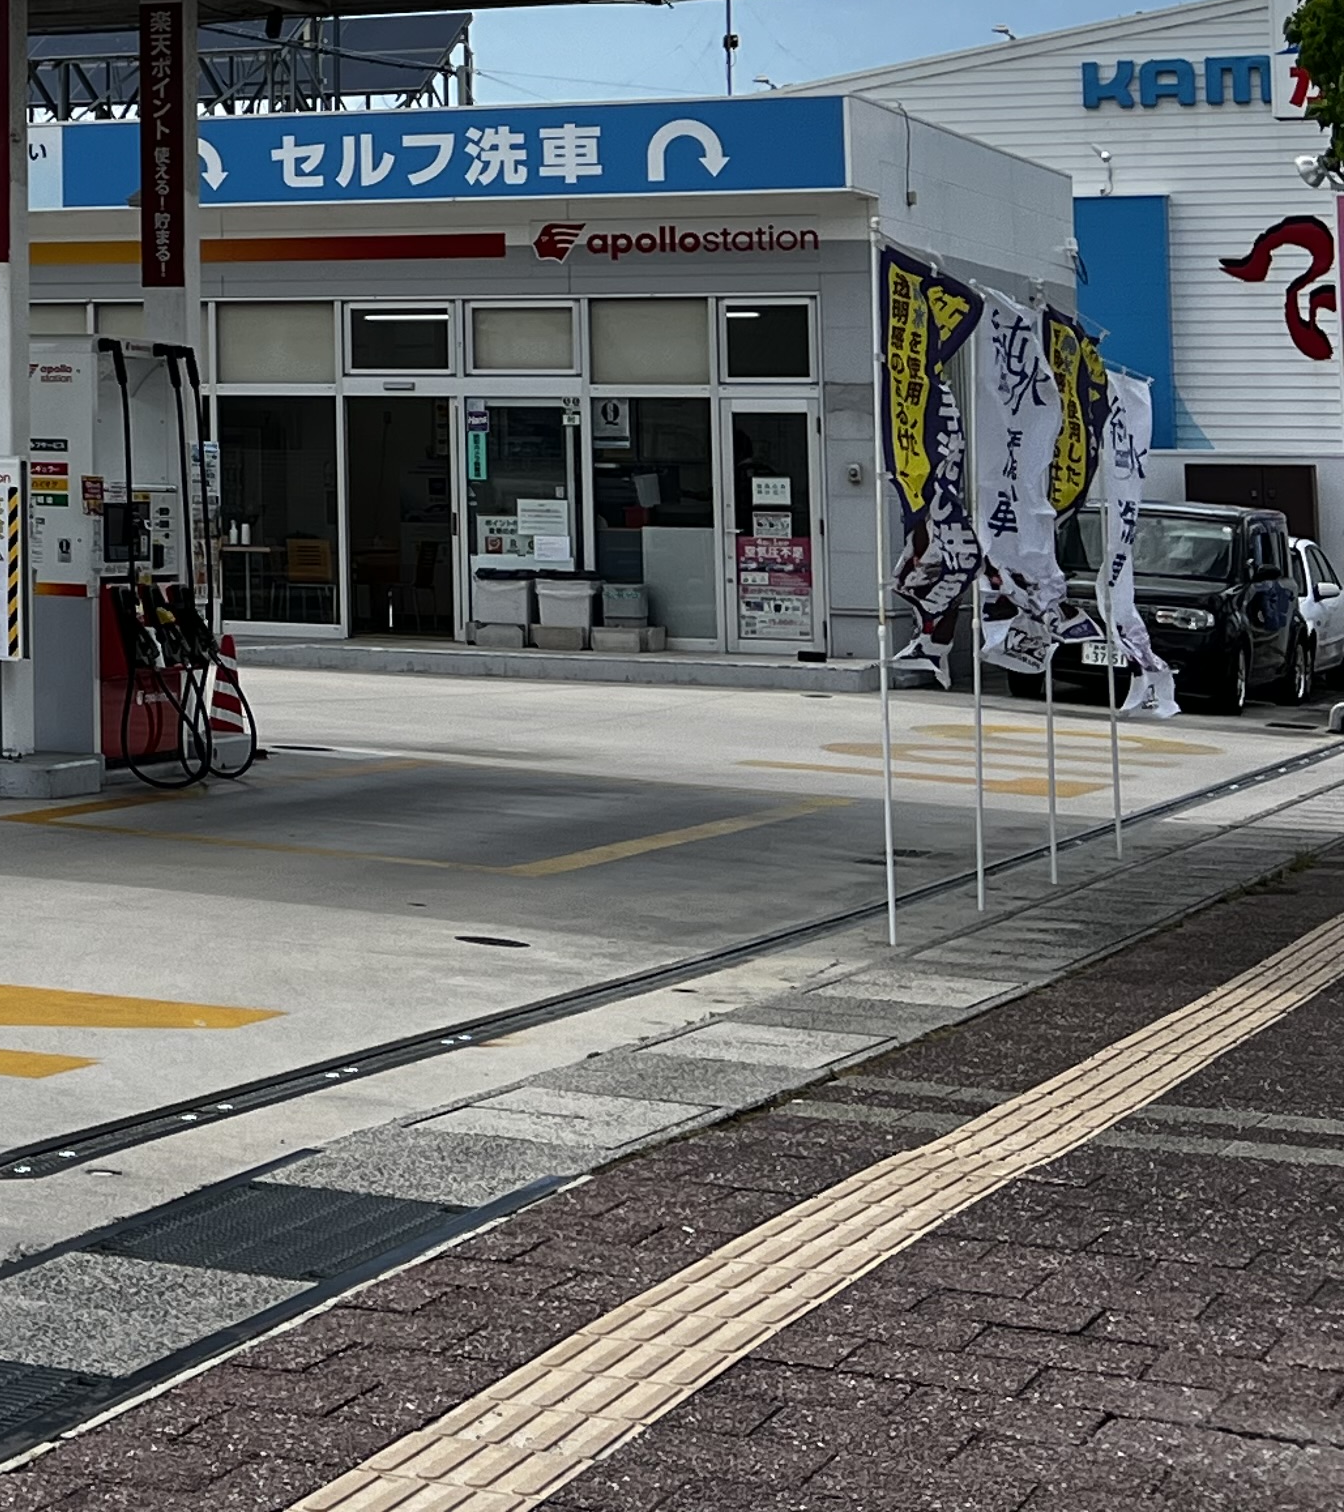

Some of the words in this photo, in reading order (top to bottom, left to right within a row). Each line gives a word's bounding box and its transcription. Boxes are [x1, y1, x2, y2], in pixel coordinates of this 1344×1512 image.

[150, 10, 172, 141] 楽天ポイント
[271, 122, 604, 188] セルフ洗車
[587, 225, 819, 261] apollostation
